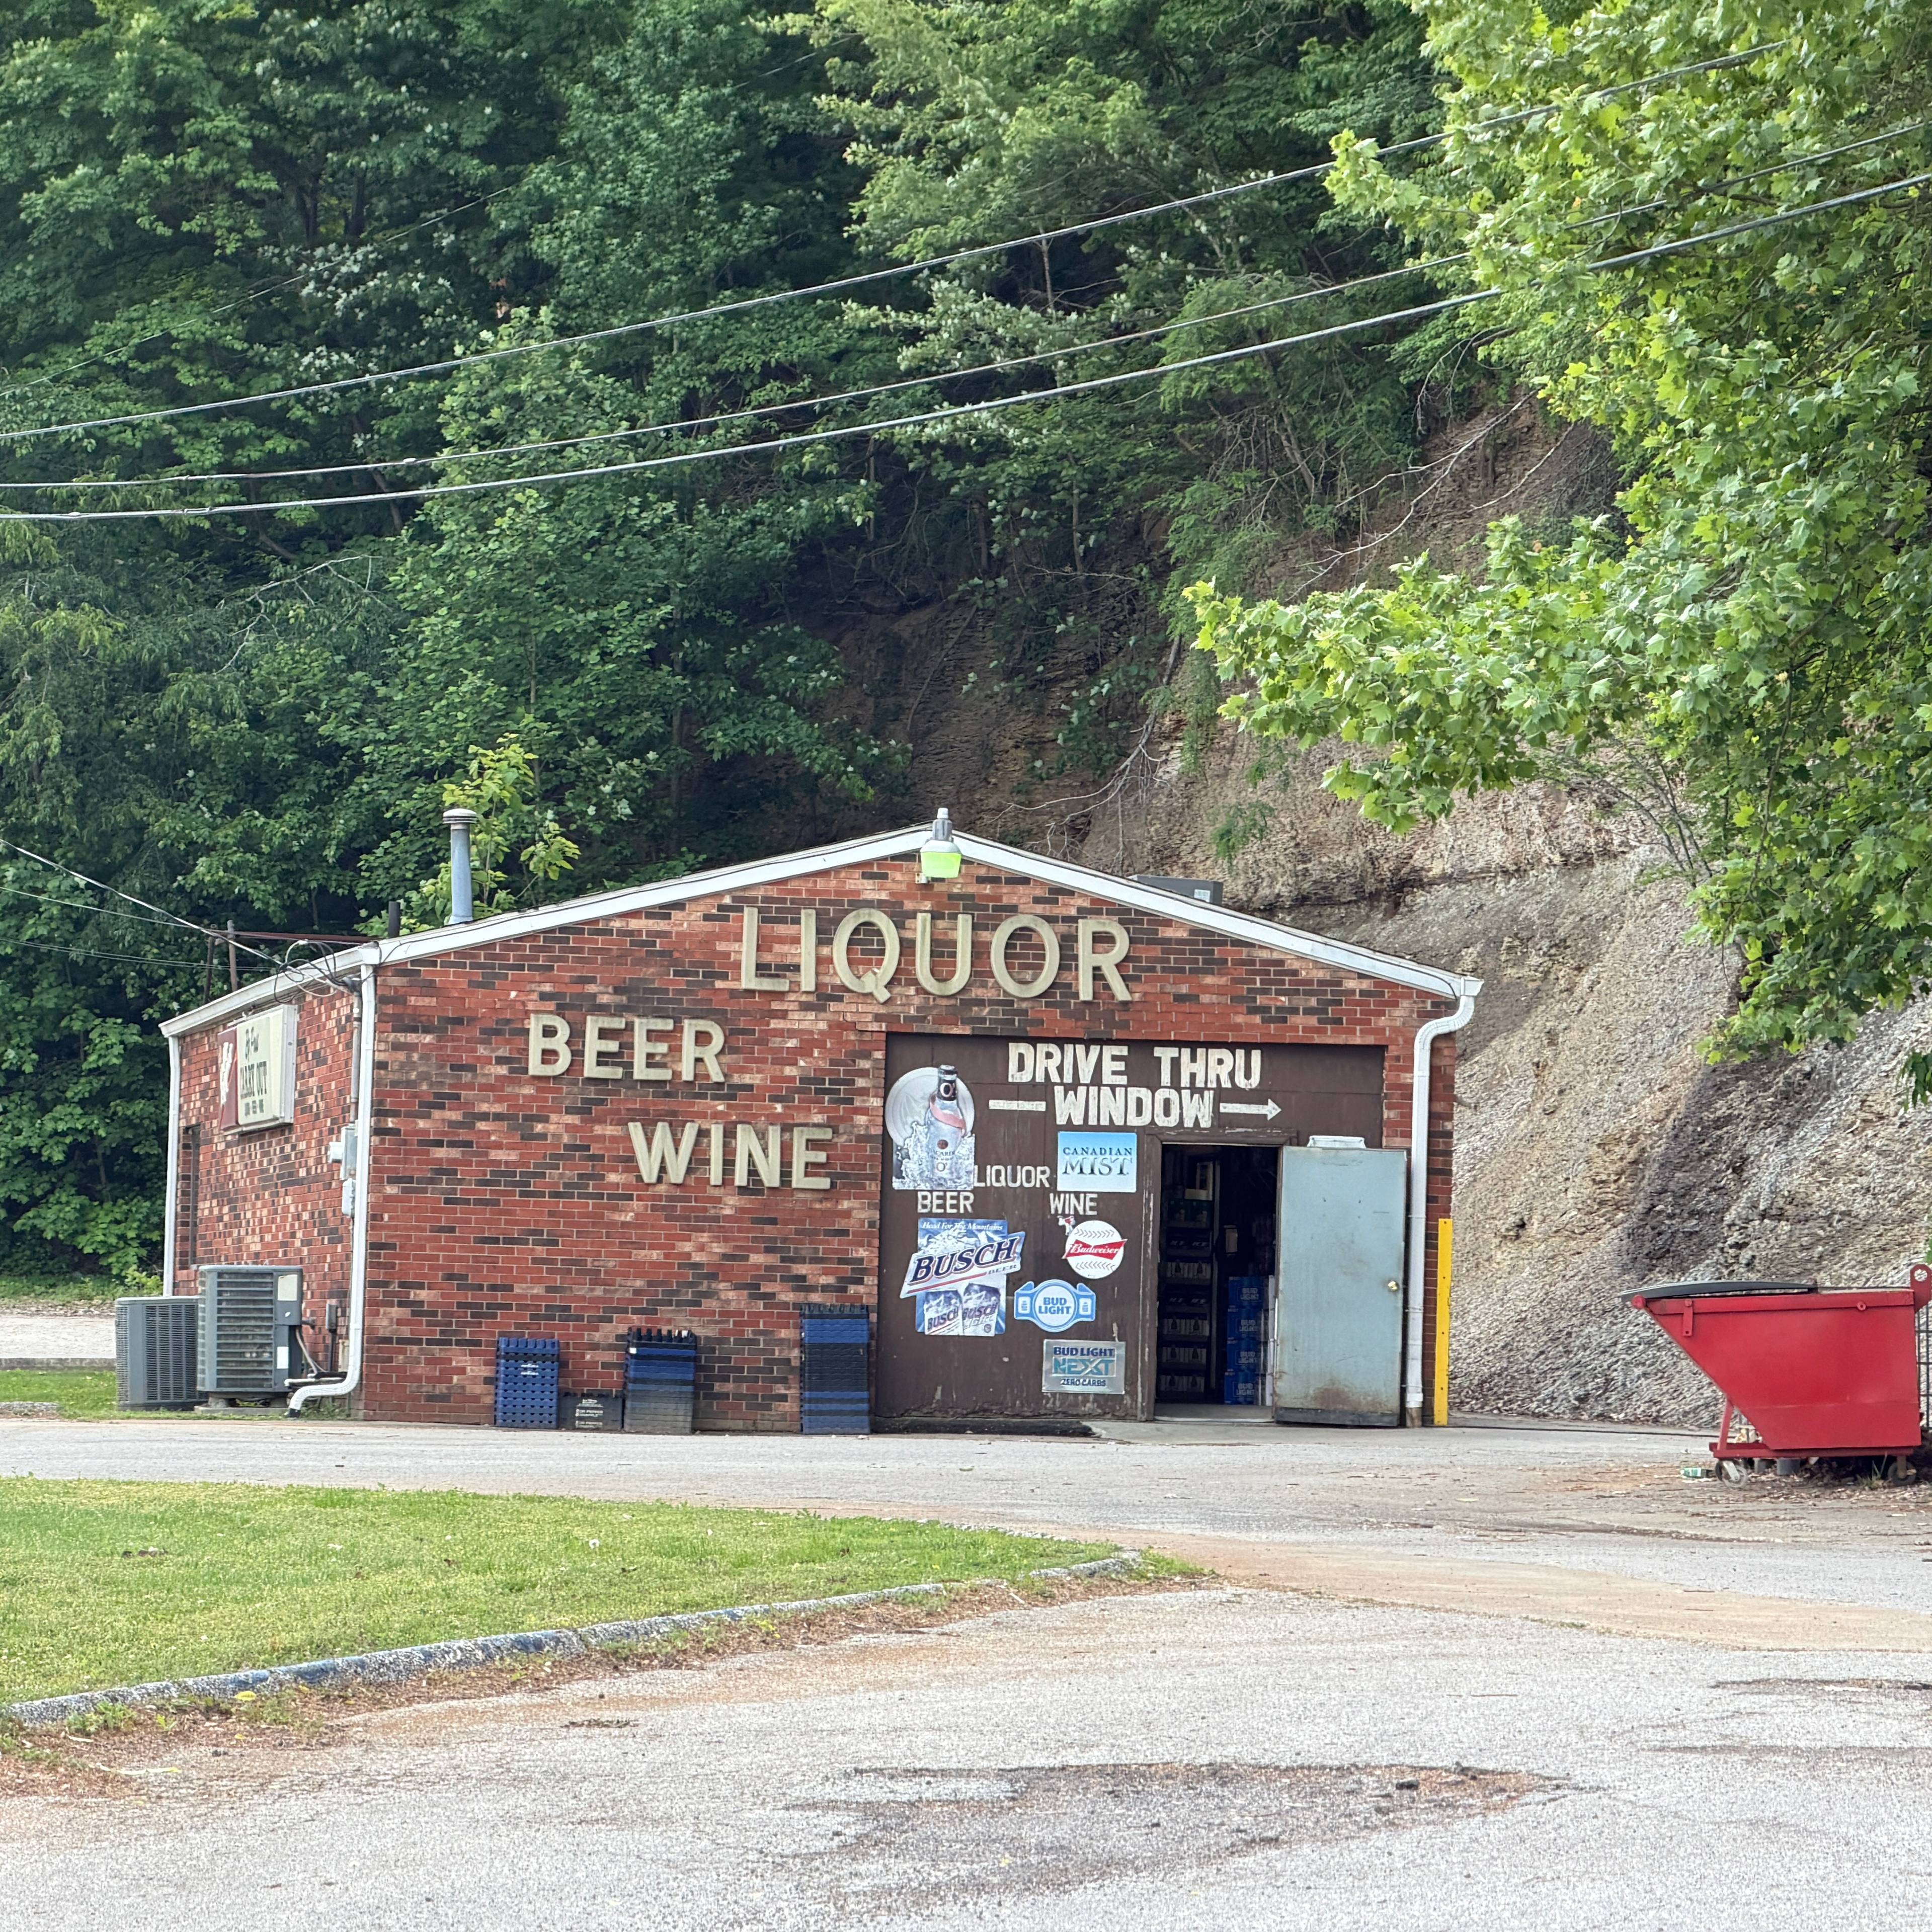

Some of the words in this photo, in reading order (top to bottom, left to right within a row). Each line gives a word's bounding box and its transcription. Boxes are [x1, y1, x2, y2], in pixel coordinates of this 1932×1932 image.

[741, 906, 1133, 1004] LIQUOR
[528, 1013, 725, 1083] BEER
[1008, 1042, 1129, 1085] DRIVE
[1154, 1046, 1261, 1089] THRU
[1054, 1086, 1214, 1128] WINDOW
[628, 1121, 832, 1189] WINE
[1063, 1147, 1132, 1156] CANADIAN
[974, 1165, 1050, 1187] LIQUOR
[1062, 1157, 1133, 1176] MIST
[918, 1191, 974, 1213] BEER
[1050, 1193, 1098, 1215] WINE
[967, 1223, 1003, 1231] Mountains
[1070, 1244, 1119, 1254] Budweiser
[908, 1236, 1021, 1285] BUSCH
[988, 1264, 1017, 1274] BEER
[962, 1302, 998, 1320] BUSCH
[1038, 1306, 1072, 1315] LIGHT
[1043, 1297, 1067, 1306] BUD
[927, 1307, 959, 1331] BUSCH
[1054, 1347, 1079, 1356] BUD
[1080, 1348, 1114, 1357] LIGHT
[1054, 1358, 1115, 1376] NEXT
